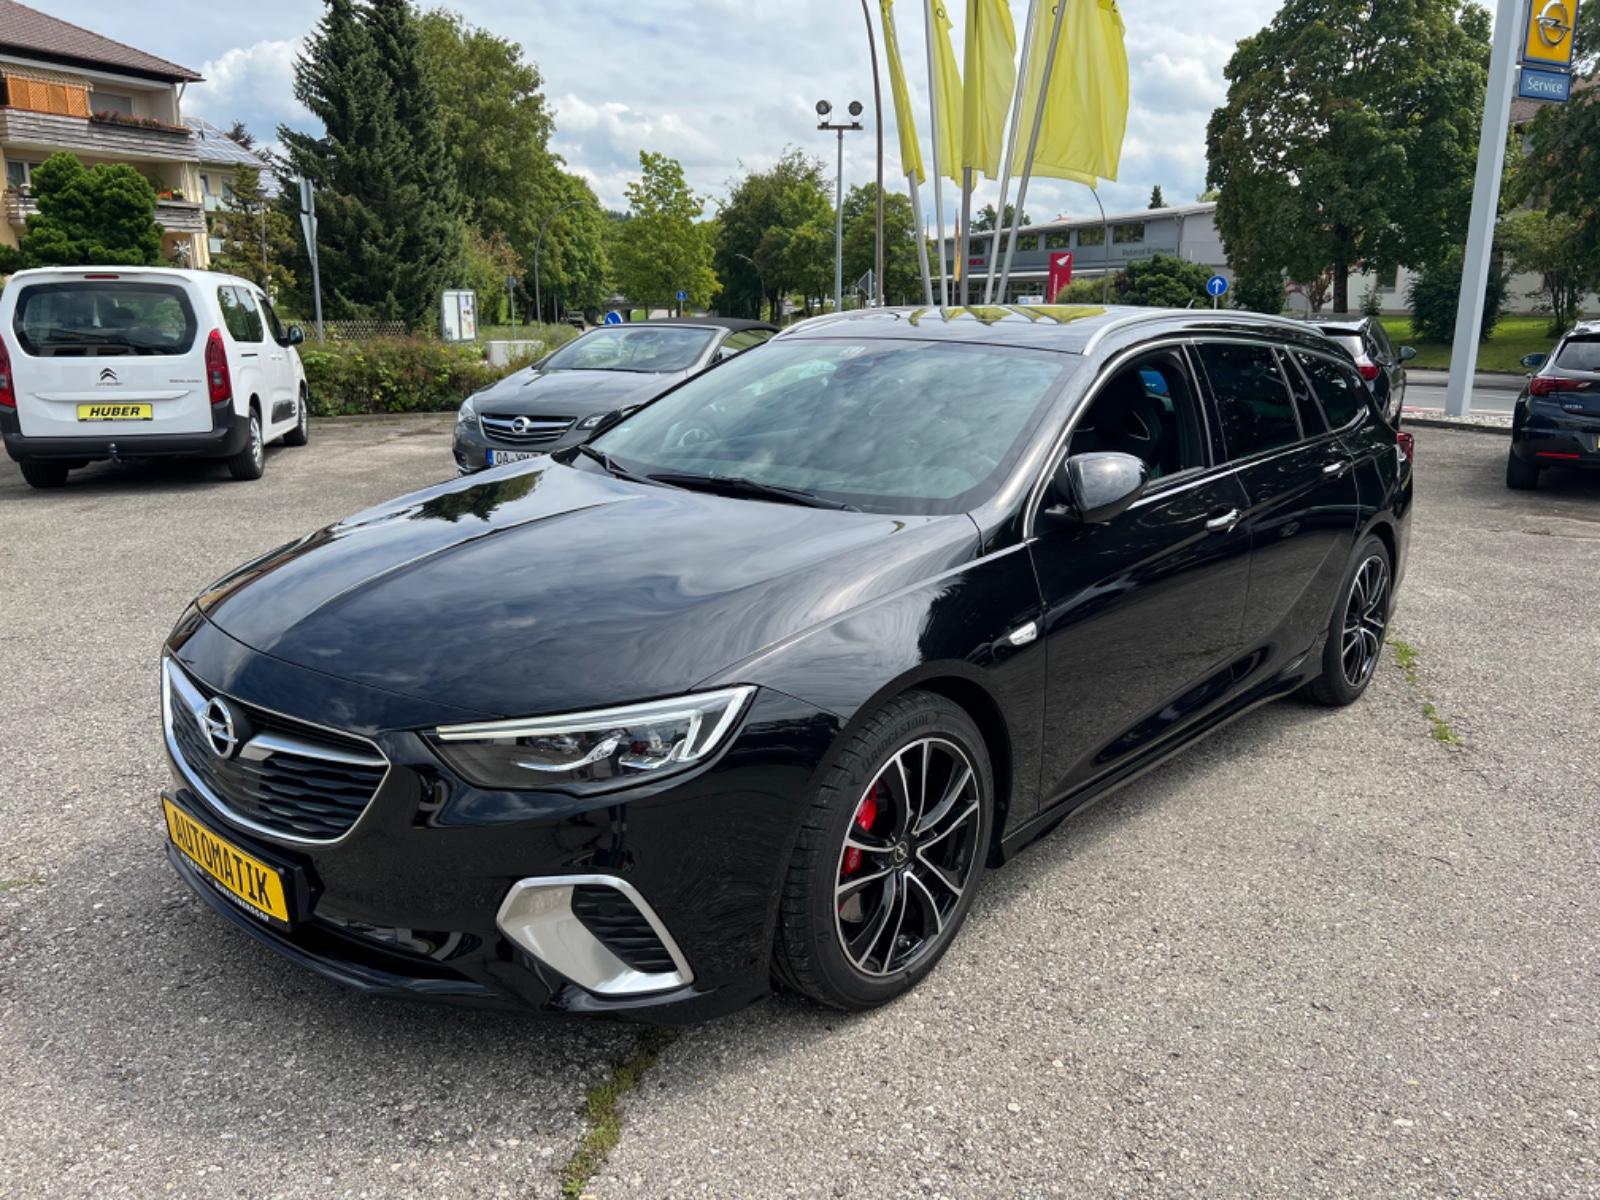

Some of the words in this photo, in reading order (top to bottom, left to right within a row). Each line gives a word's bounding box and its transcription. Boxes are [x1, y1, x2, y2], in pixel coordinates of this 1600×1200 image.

[1527, 76, 1563, 93] Service
[89, 406, 141, 417] HUBER
[173, 811, 272, 910] AUTOMATIK
